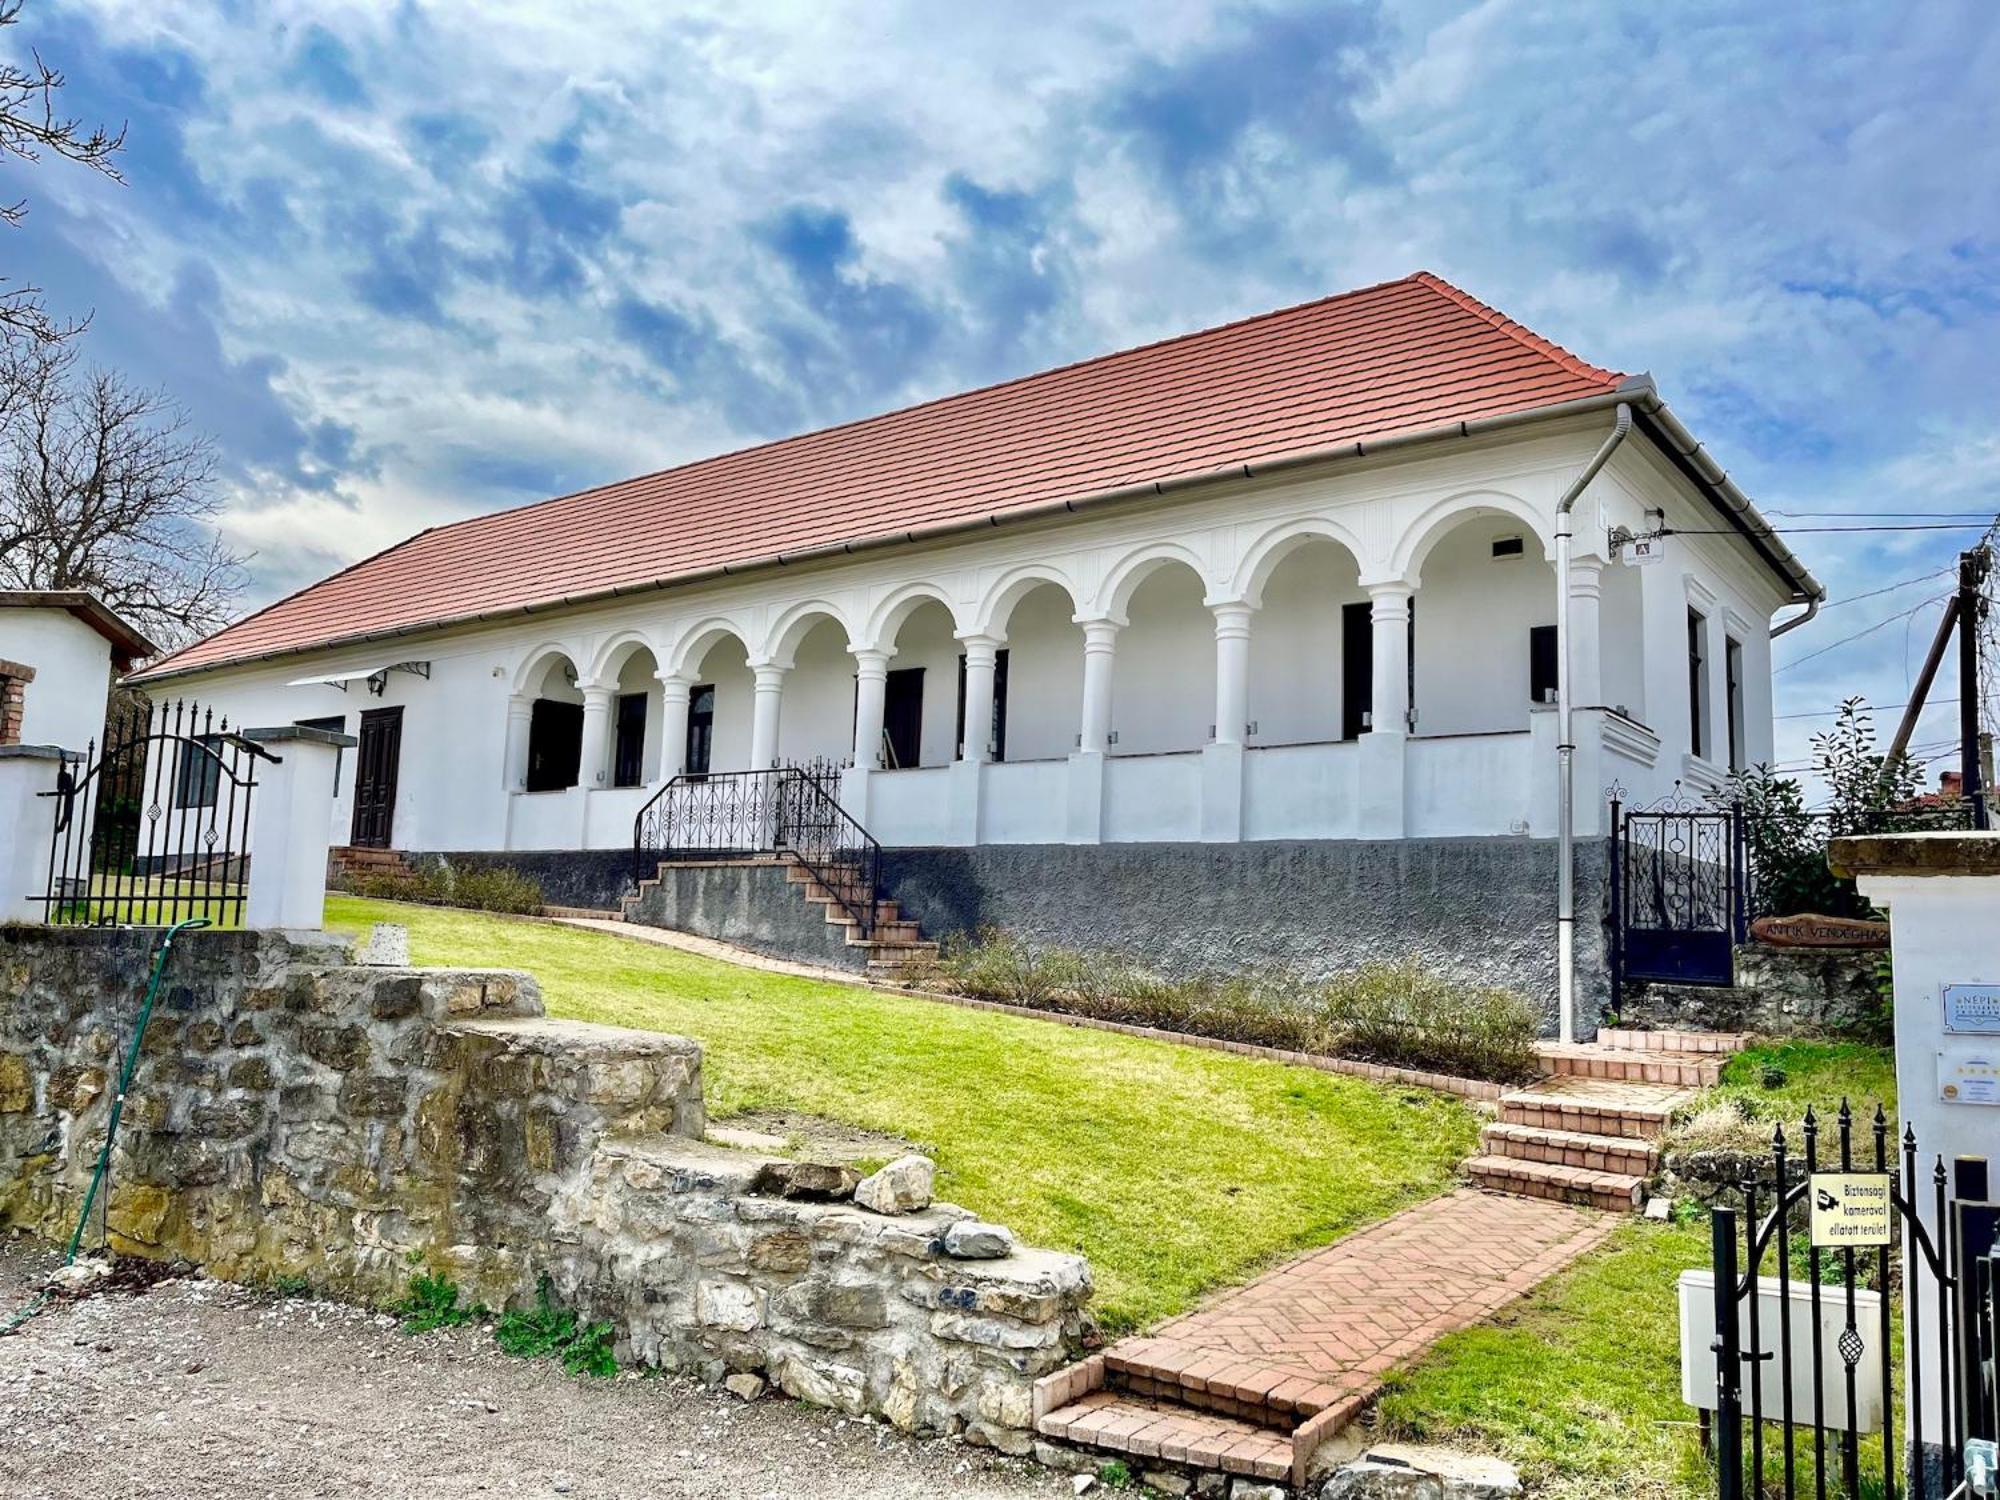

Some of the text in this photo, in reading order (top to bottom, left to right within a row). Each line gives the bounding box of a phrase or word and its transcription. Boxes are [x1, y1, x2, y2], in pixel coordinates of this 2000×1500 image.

[1767, 924, 1803, 937] ANTIK
[1844, 1184, 1886, 1199] Biztonsági
[1843, 1202, 1886, 1216] kamerával
[1860, 1222, 1886, 1236] terület
